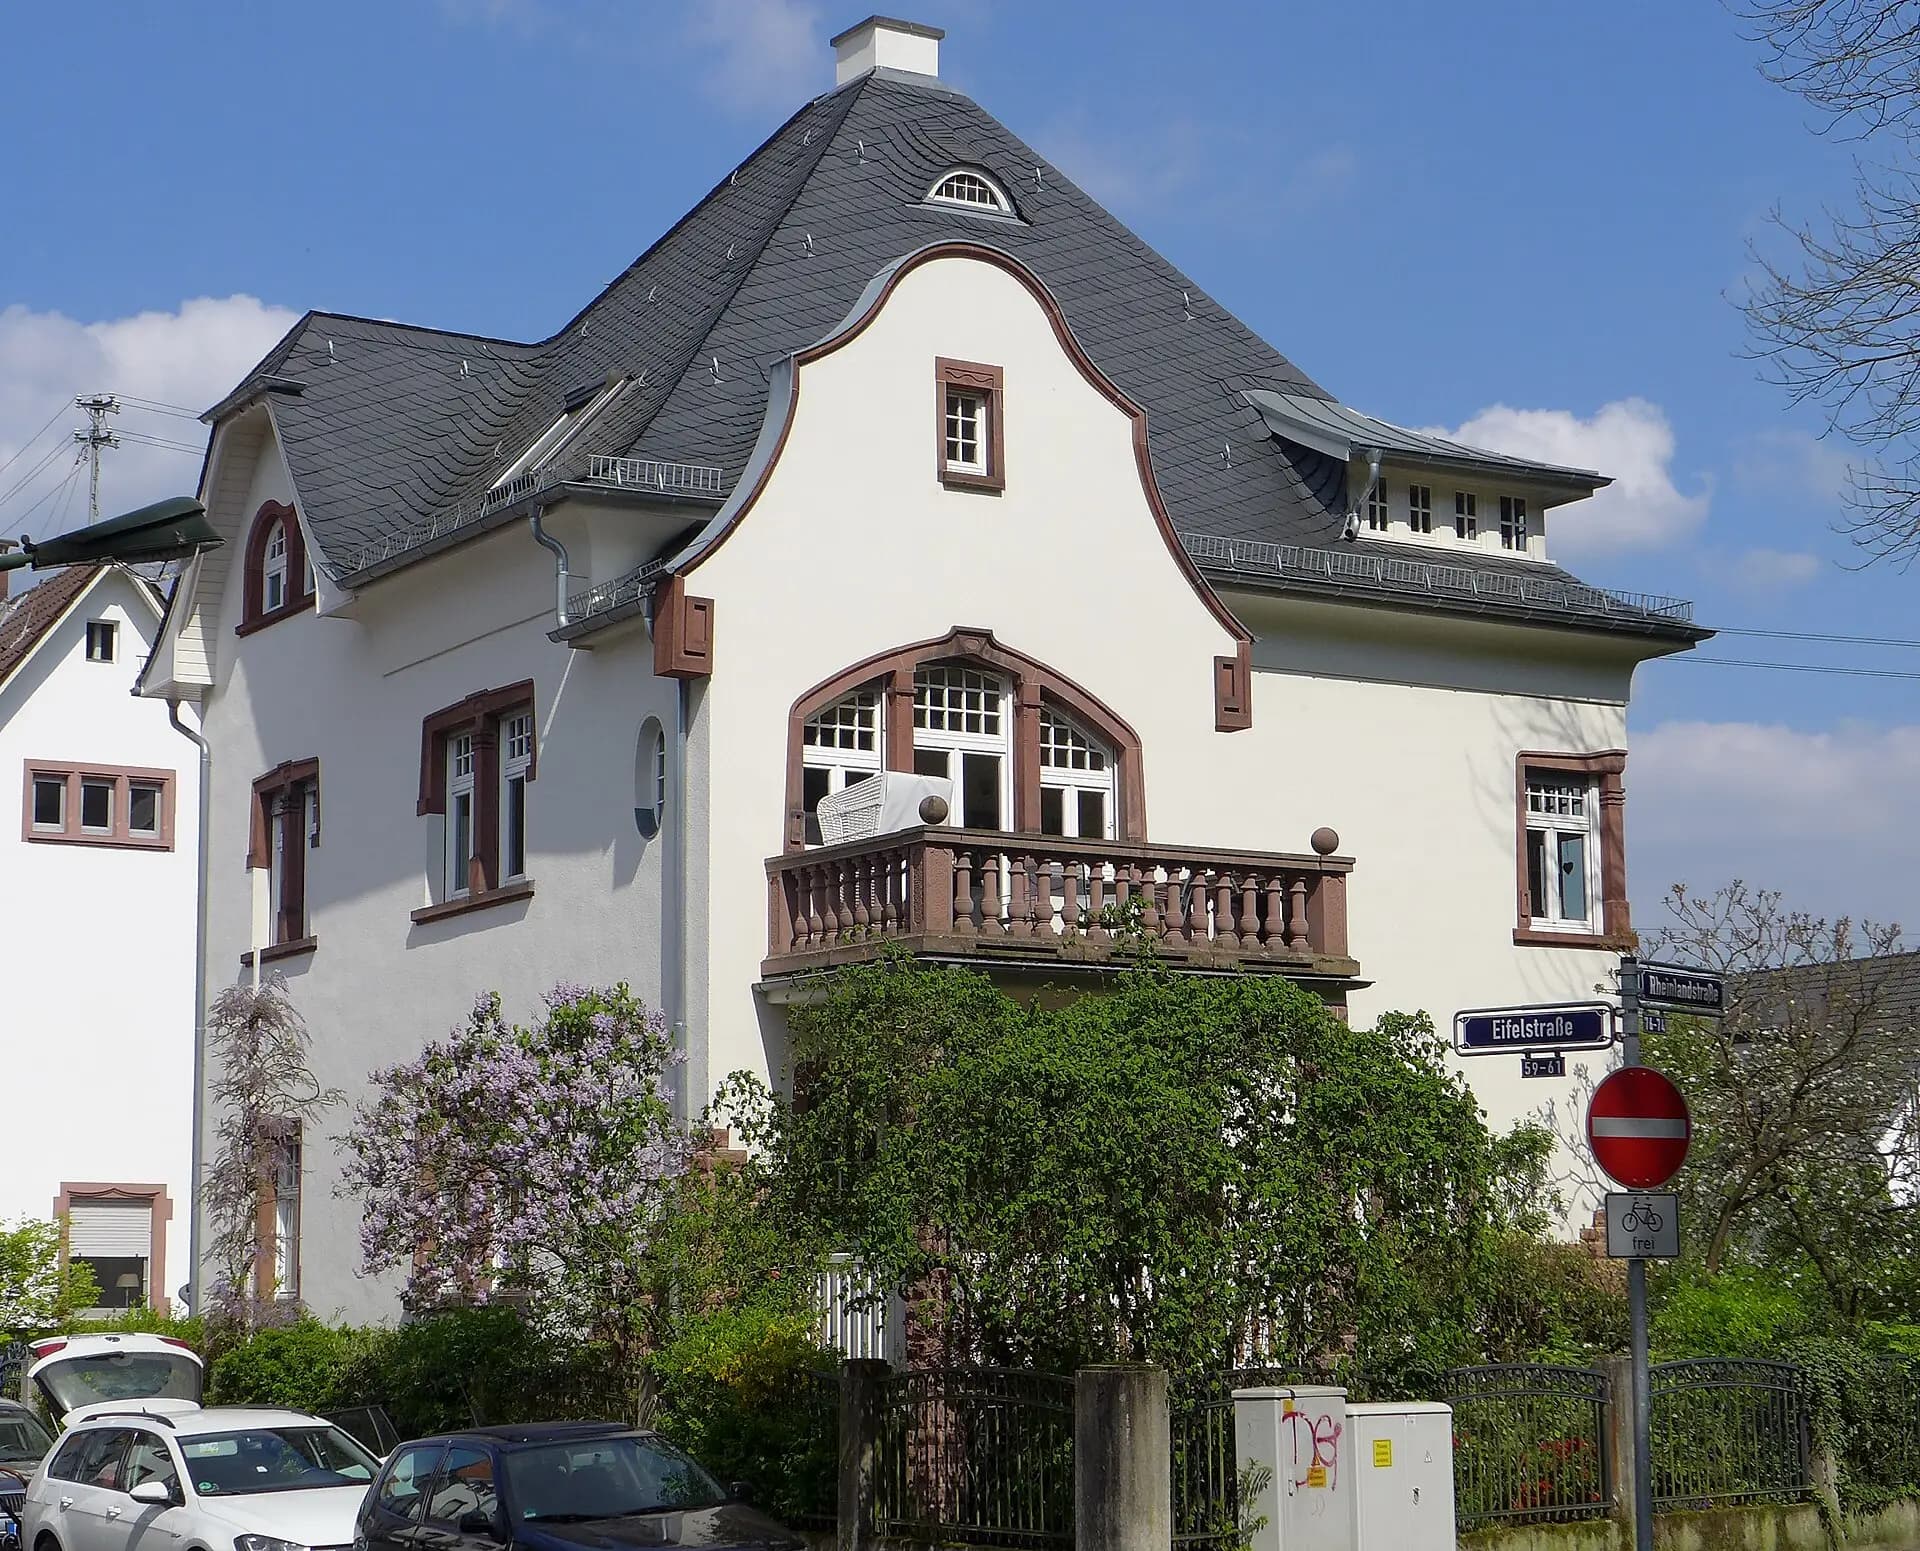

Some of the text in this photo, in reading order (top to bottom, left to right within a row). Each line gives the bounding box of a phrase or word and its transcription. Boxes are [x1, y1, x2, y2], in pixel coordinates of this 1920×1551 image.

[1649, 975, 1719, 1003] Rheinlandstraße
[1492, 1016, 1573, 1040] Eifelstraße
[1524, 1060, 1561, 1075] 59-61
[1632, 1236, 1655, 1250] frei
